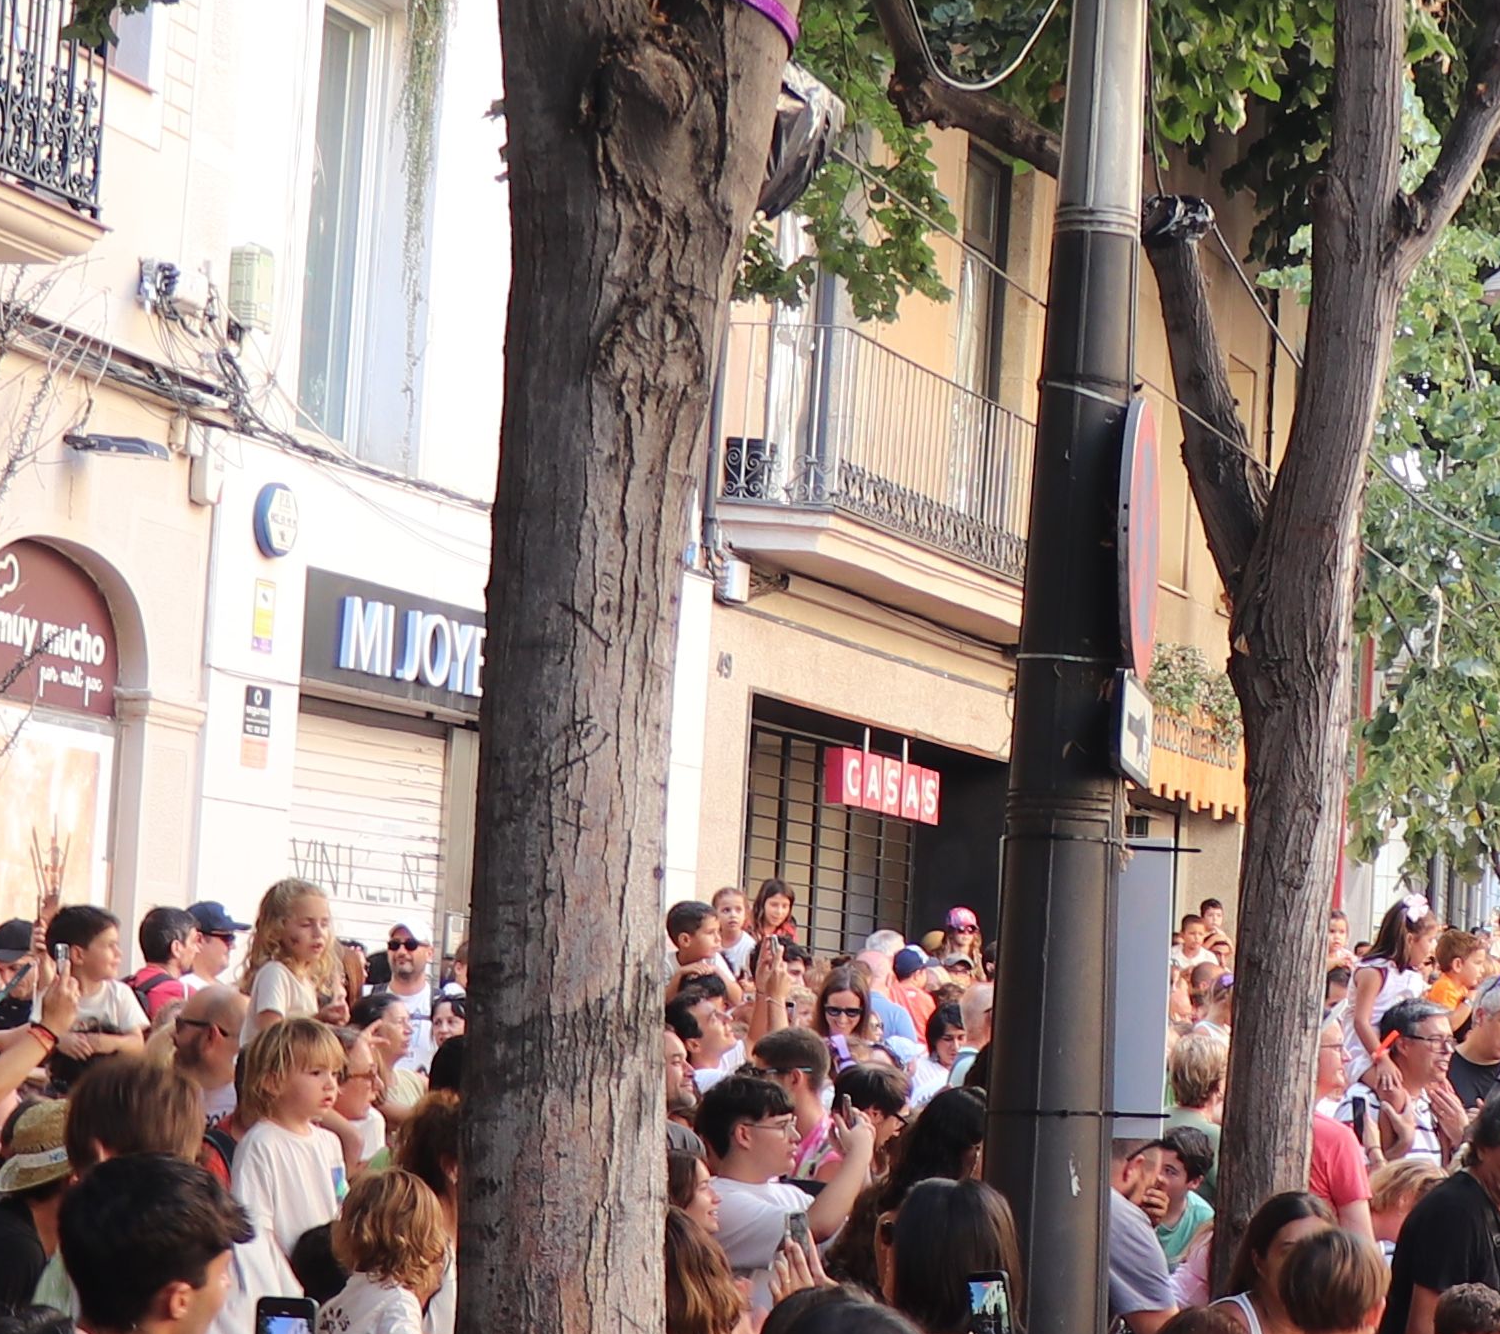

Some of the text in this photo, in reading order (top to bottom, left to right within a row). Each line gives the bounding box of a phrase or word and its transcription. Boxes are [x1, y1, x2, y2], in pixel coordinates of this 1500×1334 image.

[40, 622, 106, 666] mucho
[338, 595, 396, 678] MI
[845, 757, 938, 816] CASAS
